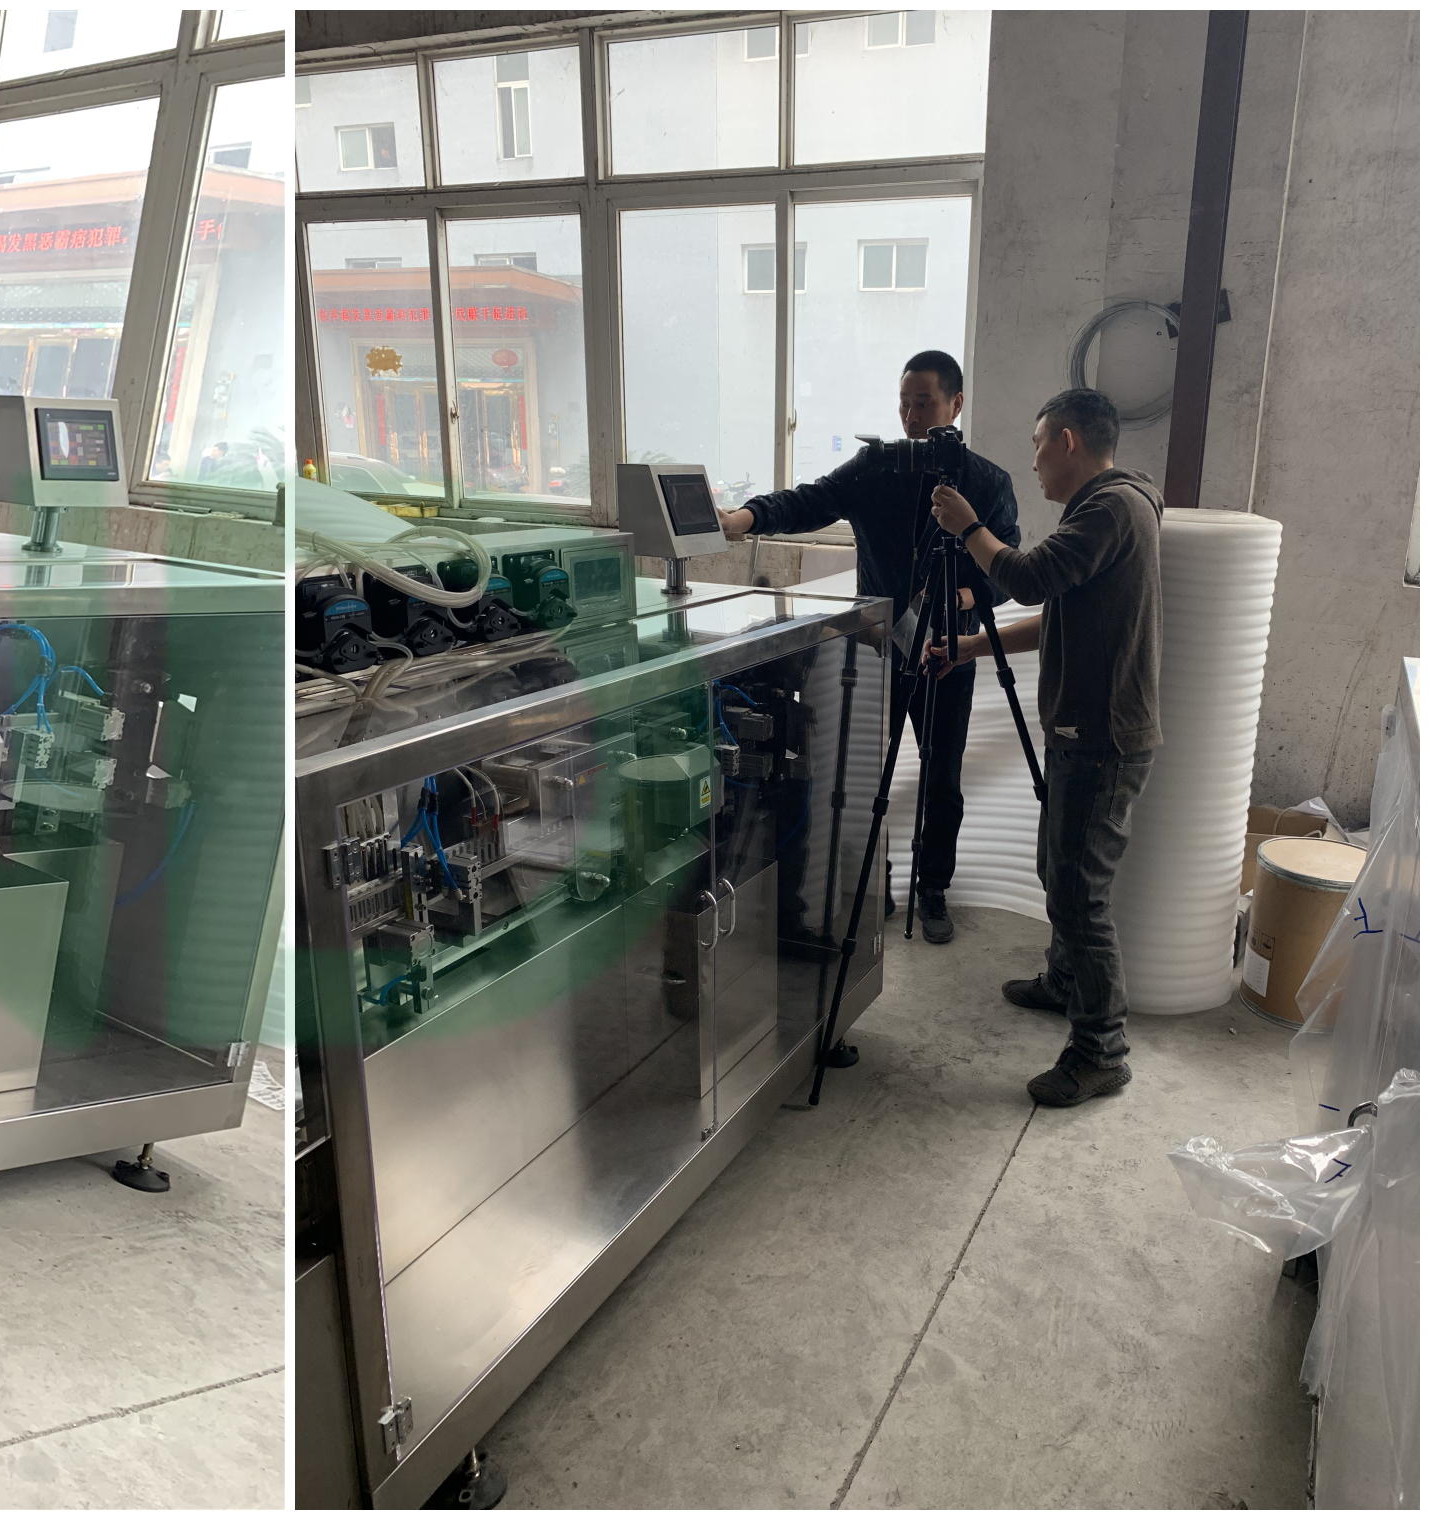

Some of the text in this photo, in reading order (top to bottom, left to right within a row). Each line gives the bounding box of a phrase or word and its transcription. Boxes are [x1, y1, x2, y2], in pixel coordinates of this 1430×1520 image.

[452, 305, 529, 321] 民联手促进社
